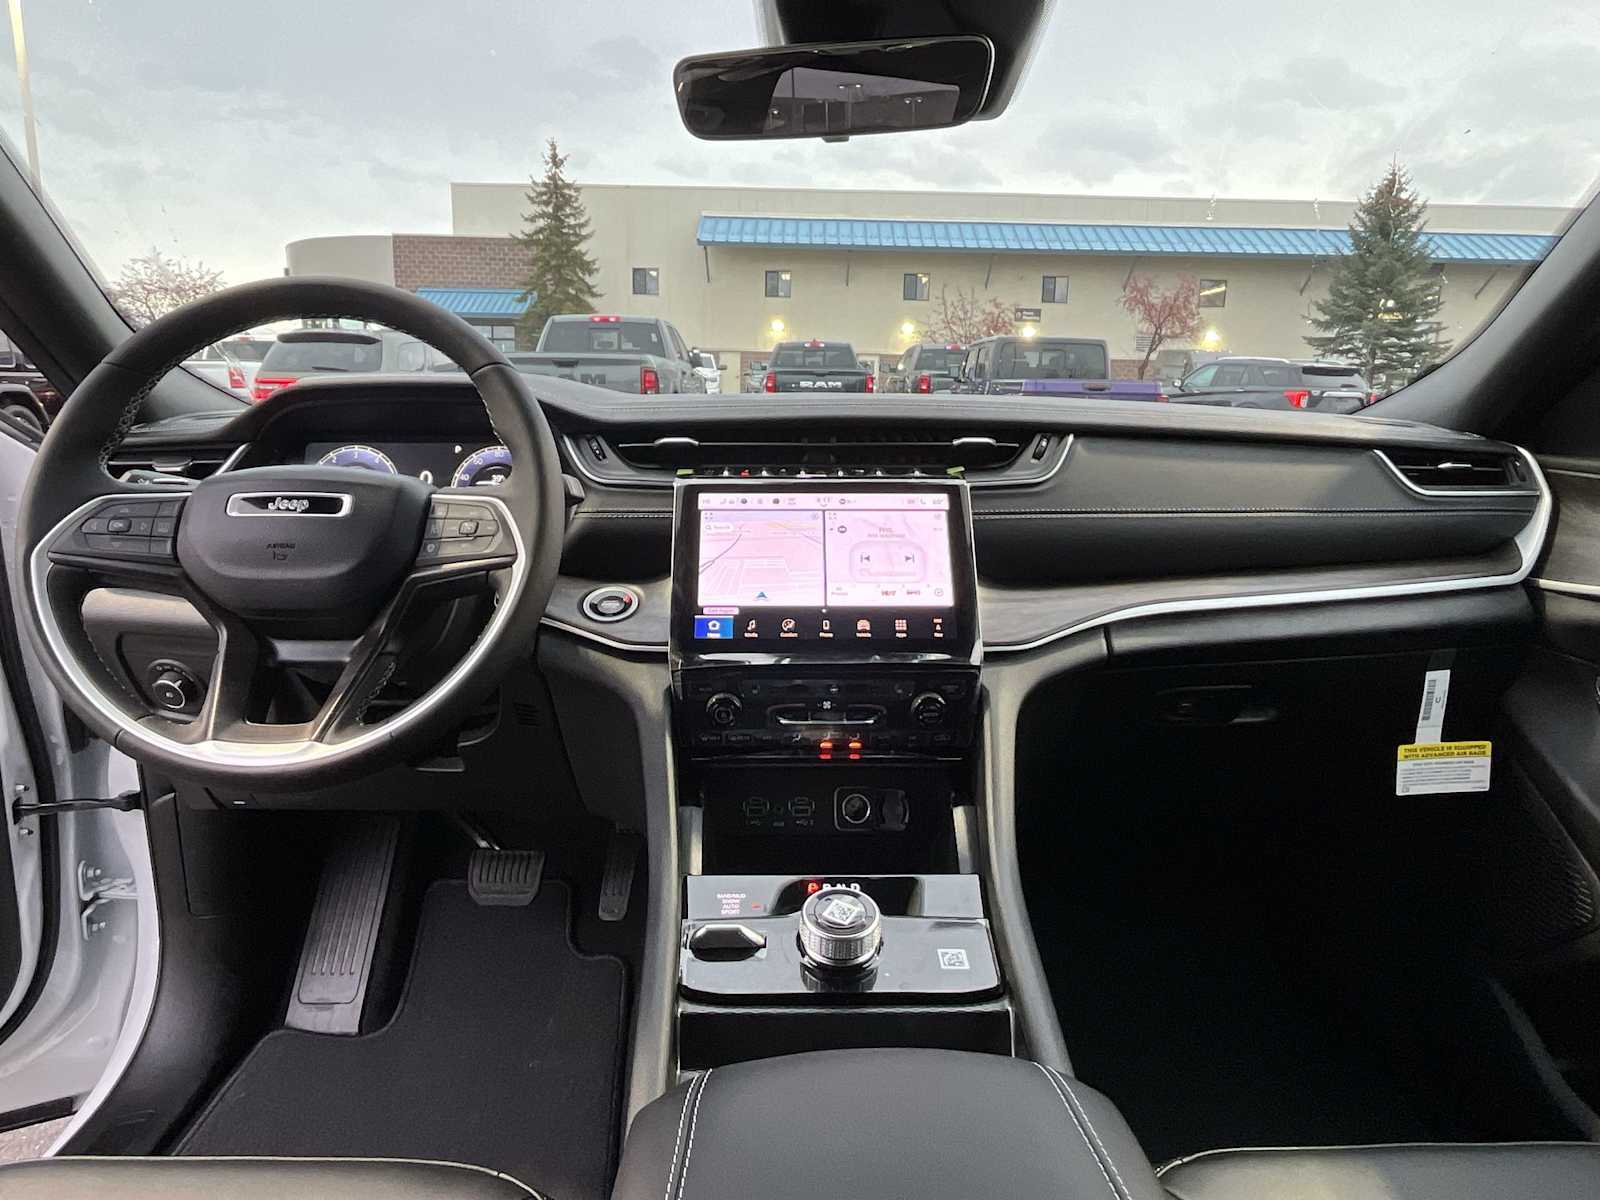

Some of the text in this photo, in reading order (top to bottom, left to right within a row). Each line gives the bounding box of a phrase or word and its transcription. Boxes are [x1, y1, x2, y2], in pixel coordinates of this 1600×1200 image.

[799, 381, 842, 389] RAM
[455, 445, 462, 454] P
[460, 473, 469, 481] 40
[268, 496, 310, 512] Jeep
